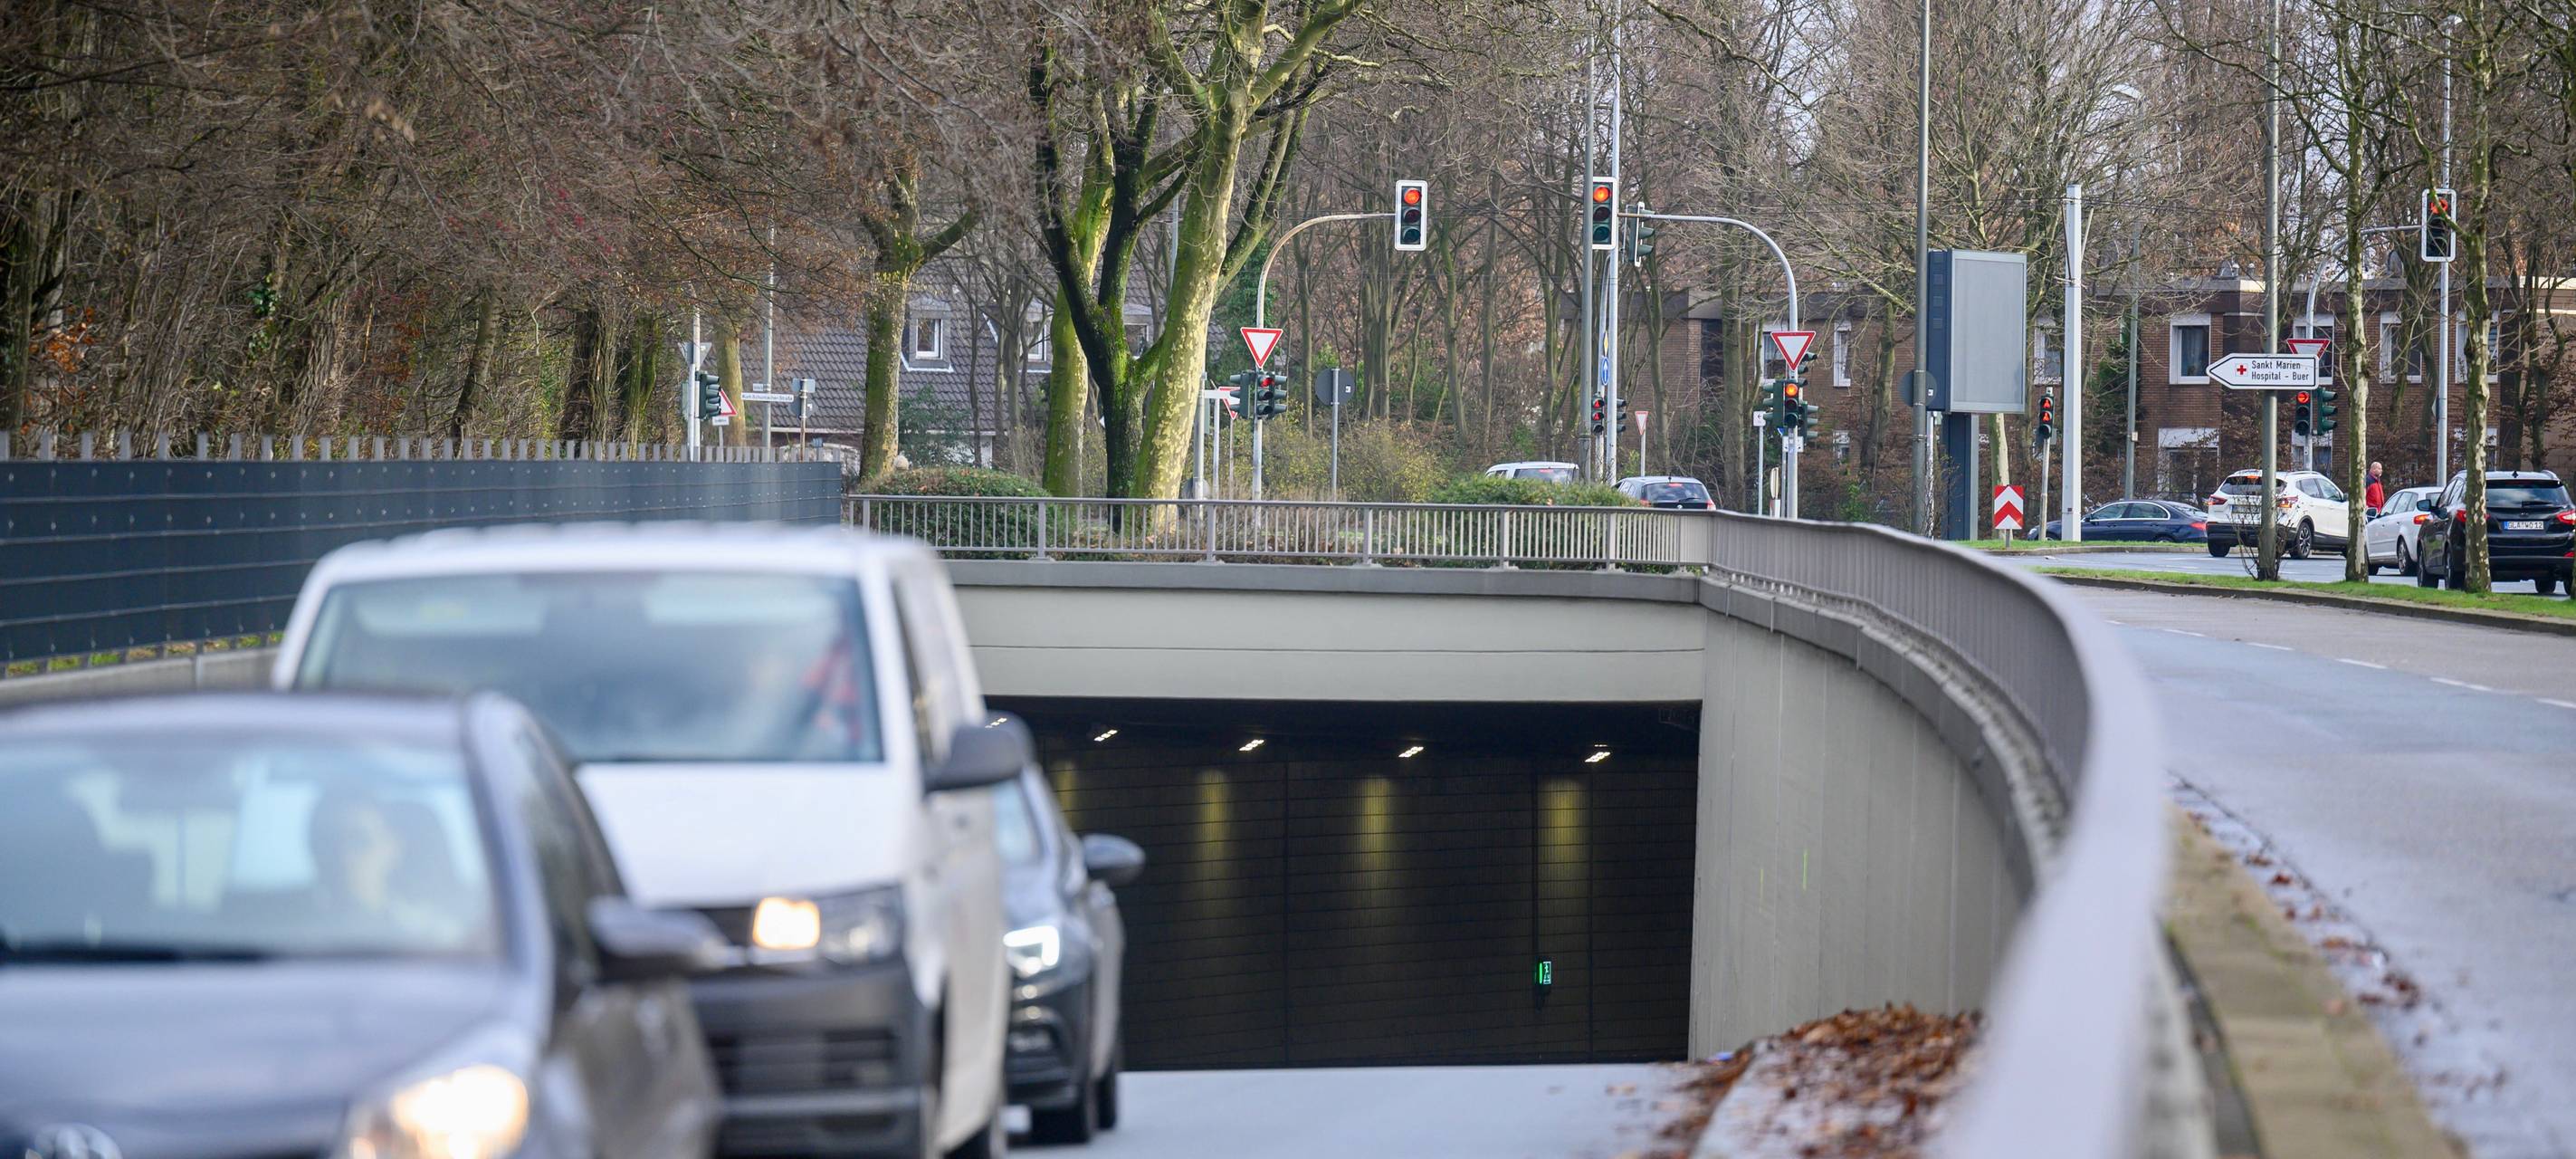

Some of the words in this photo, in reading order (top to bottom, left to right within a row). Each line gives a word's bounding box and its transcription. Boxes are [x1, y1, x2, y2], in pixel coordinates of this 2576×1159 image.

[2252, 360, 2272, 369] Sankt
[2275, 360, 2301, 369] Marien
[2252, 371, 2281, 381] Hospital
[2292, 371, 2309, 380] Buer
